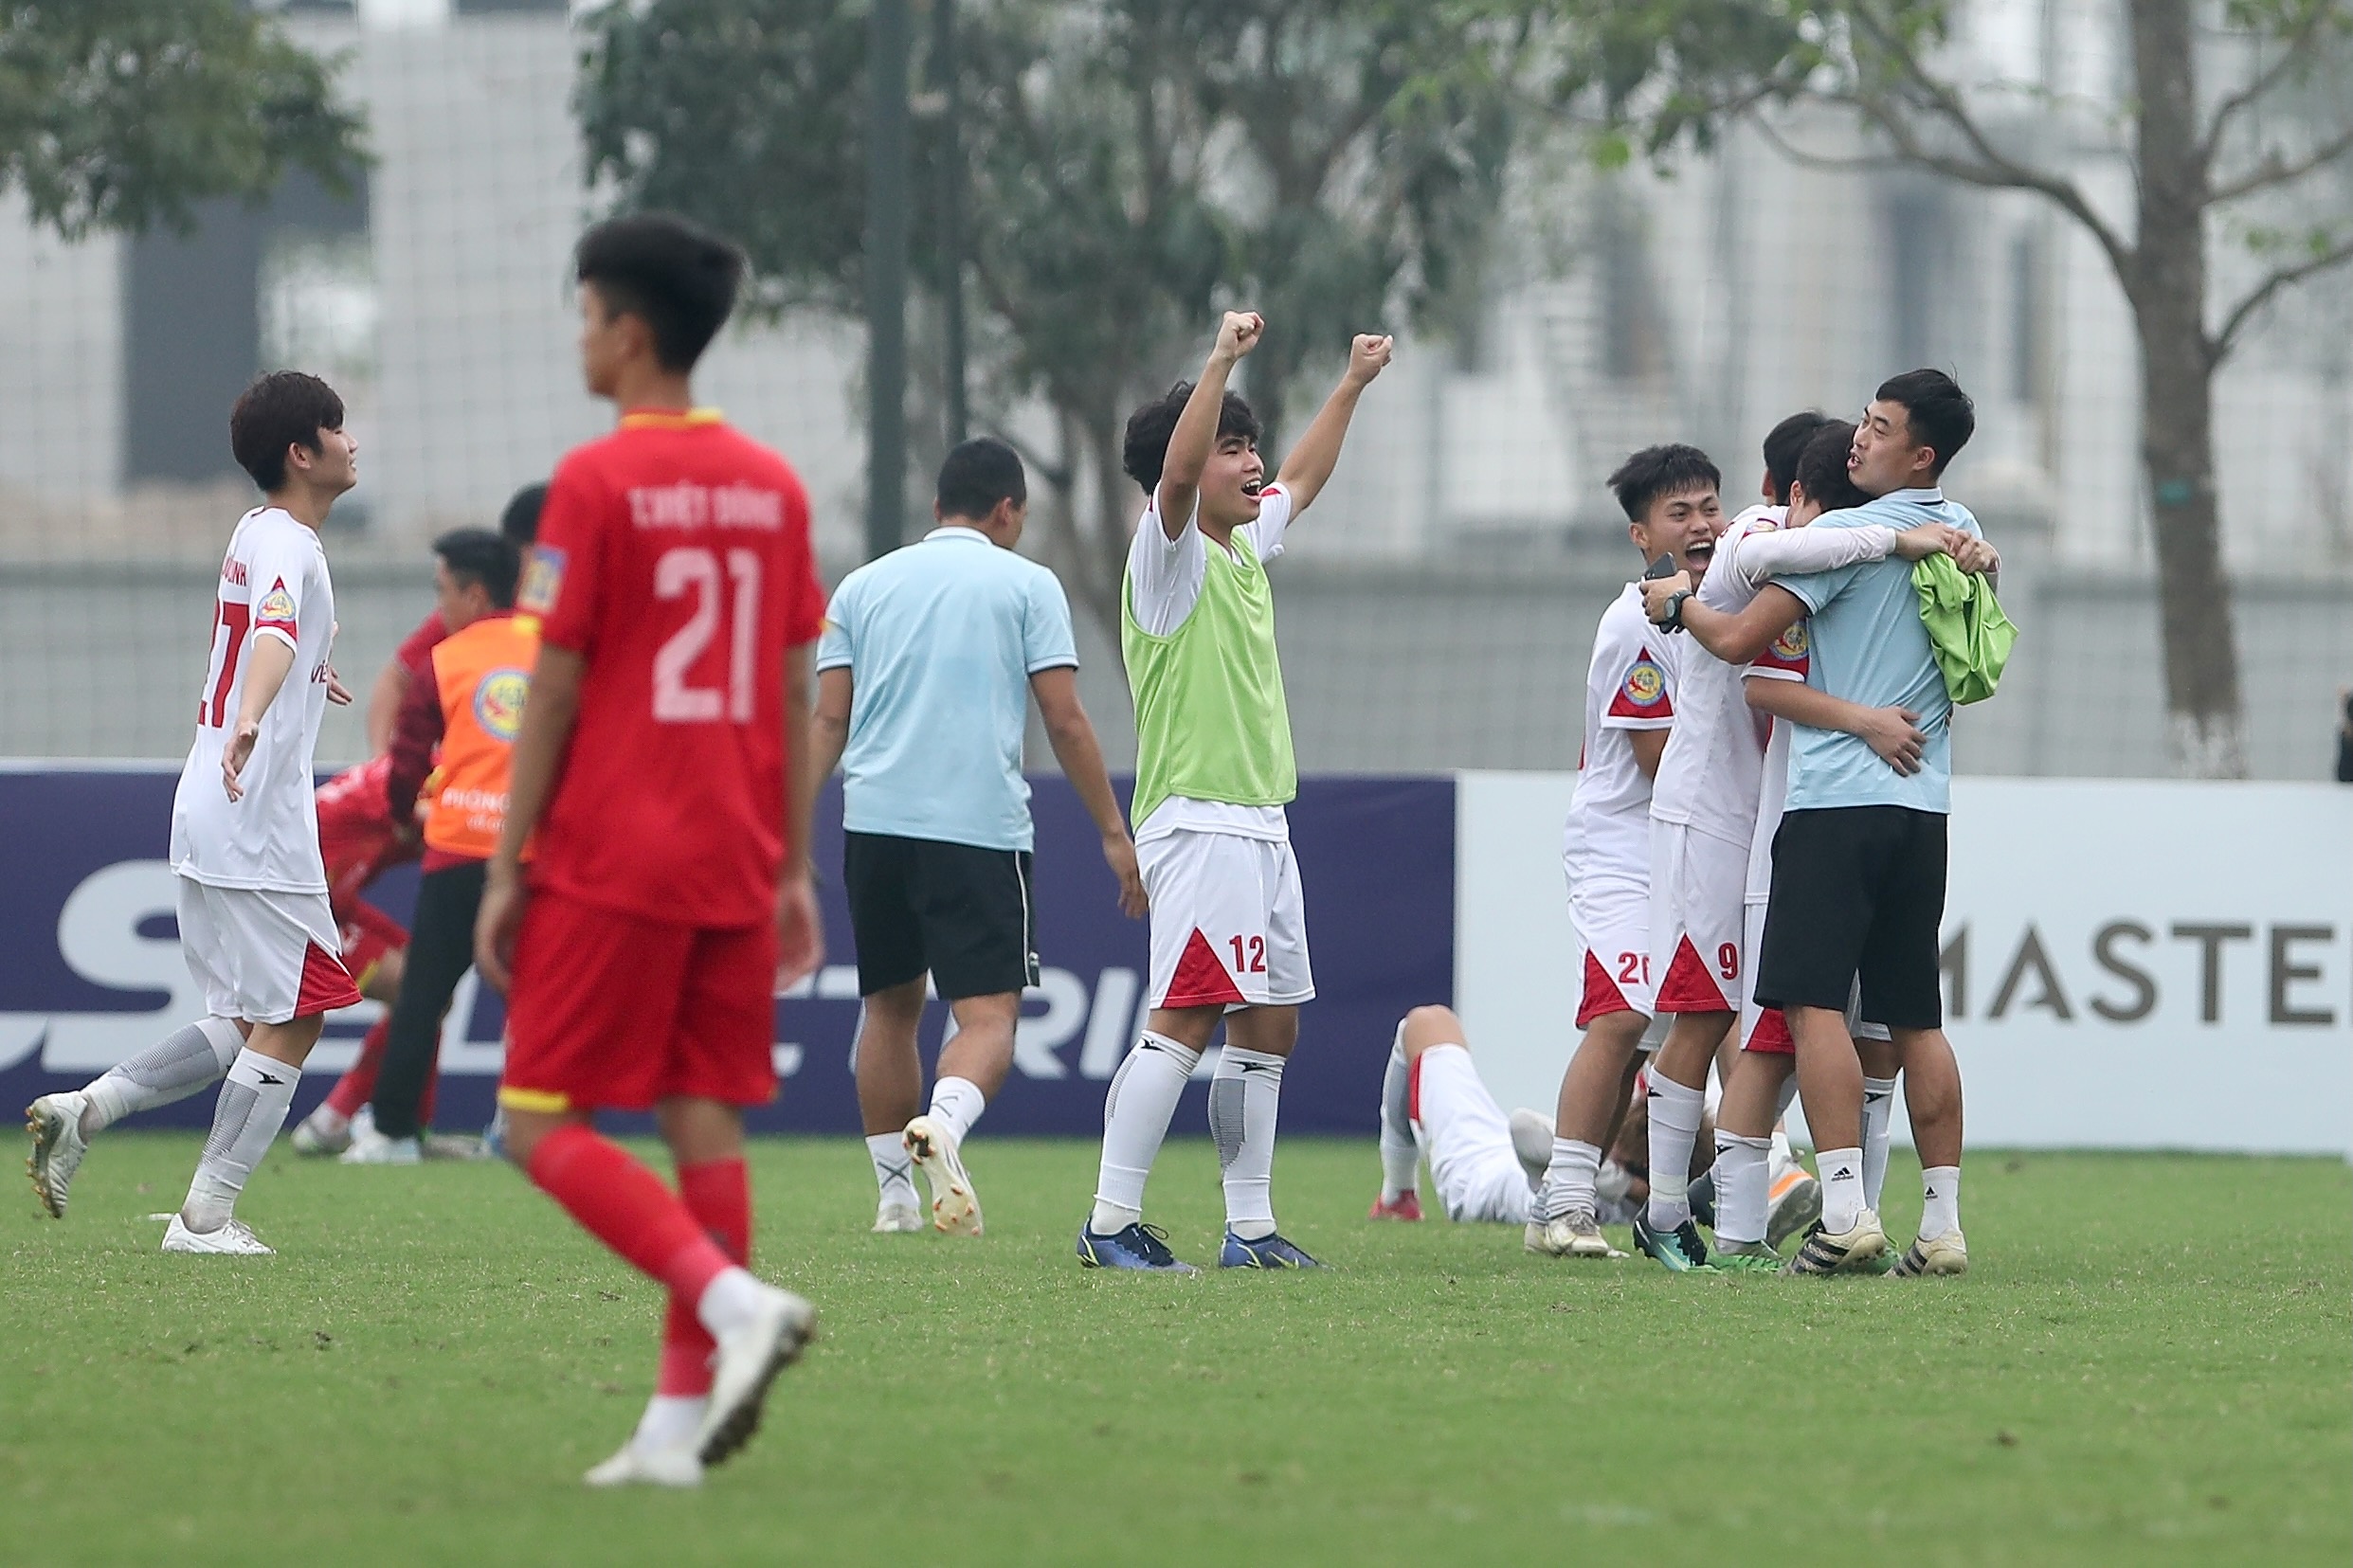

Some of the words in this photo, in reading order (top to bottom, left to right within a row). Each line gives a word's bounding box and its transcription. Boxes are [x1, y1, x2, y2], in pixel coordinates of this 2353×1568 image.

[653, 547, 761, 724] 21
[1228, 934, 1267, 973] 12
[1718, 941, 1739, 981] 9
